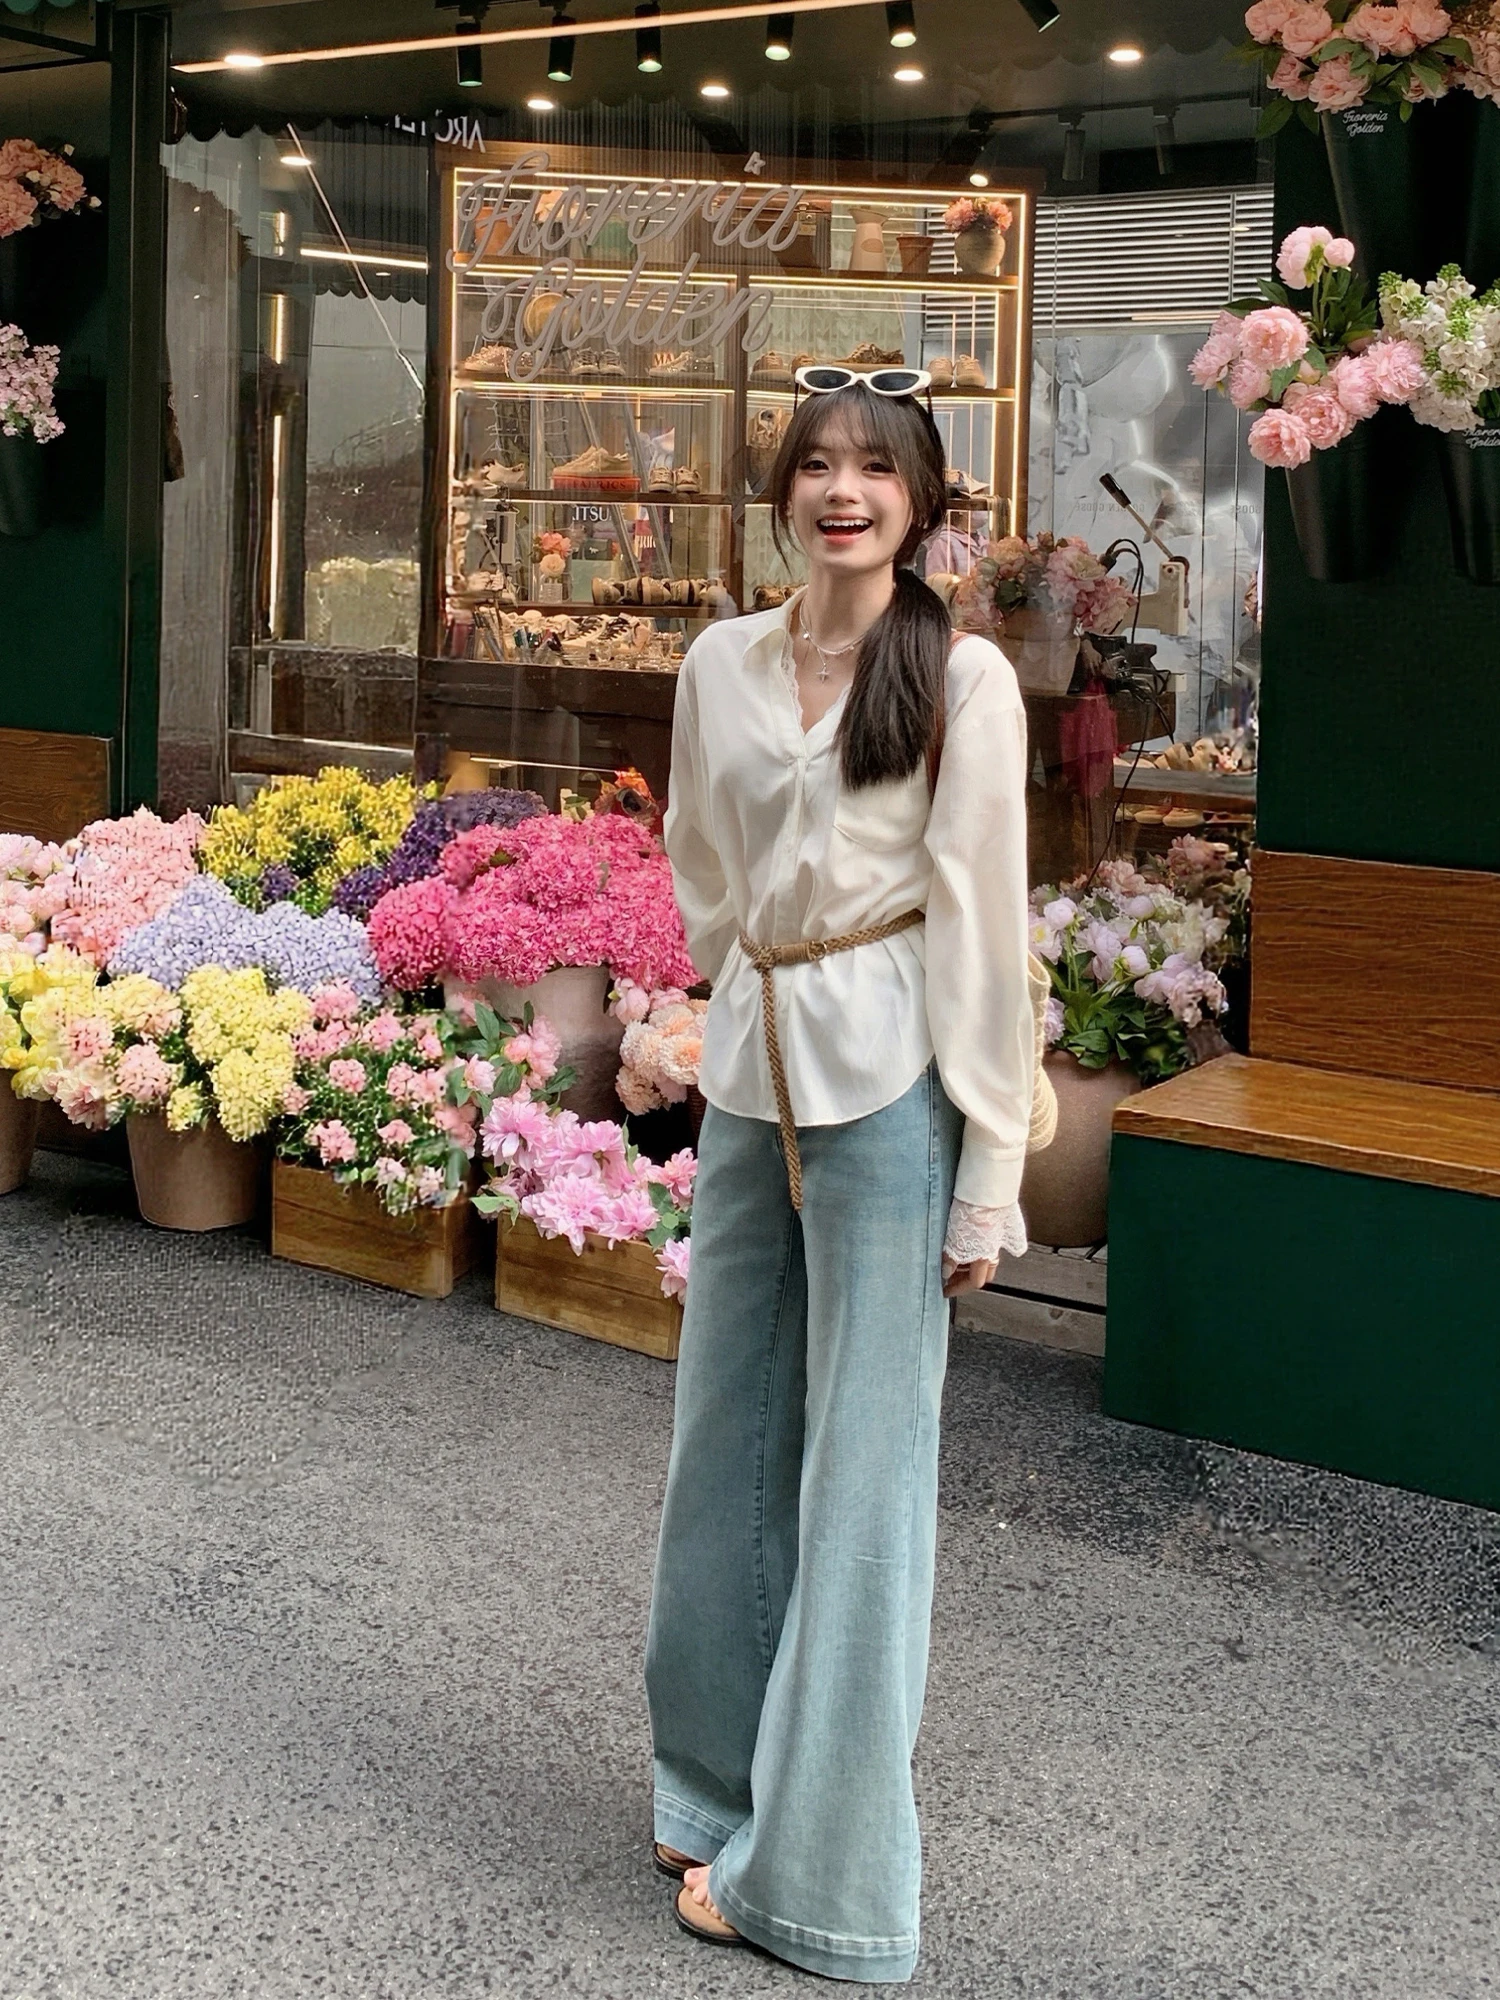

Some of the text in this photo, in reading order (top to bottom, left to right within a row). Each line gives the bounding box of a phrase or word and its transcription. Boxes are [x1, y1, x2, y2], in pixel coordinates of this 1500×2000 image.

[1346, 122, 1384, 137] Golden
[481, 252, 774, 383] Golden
[1465, 436, 1500, 449] Golde
